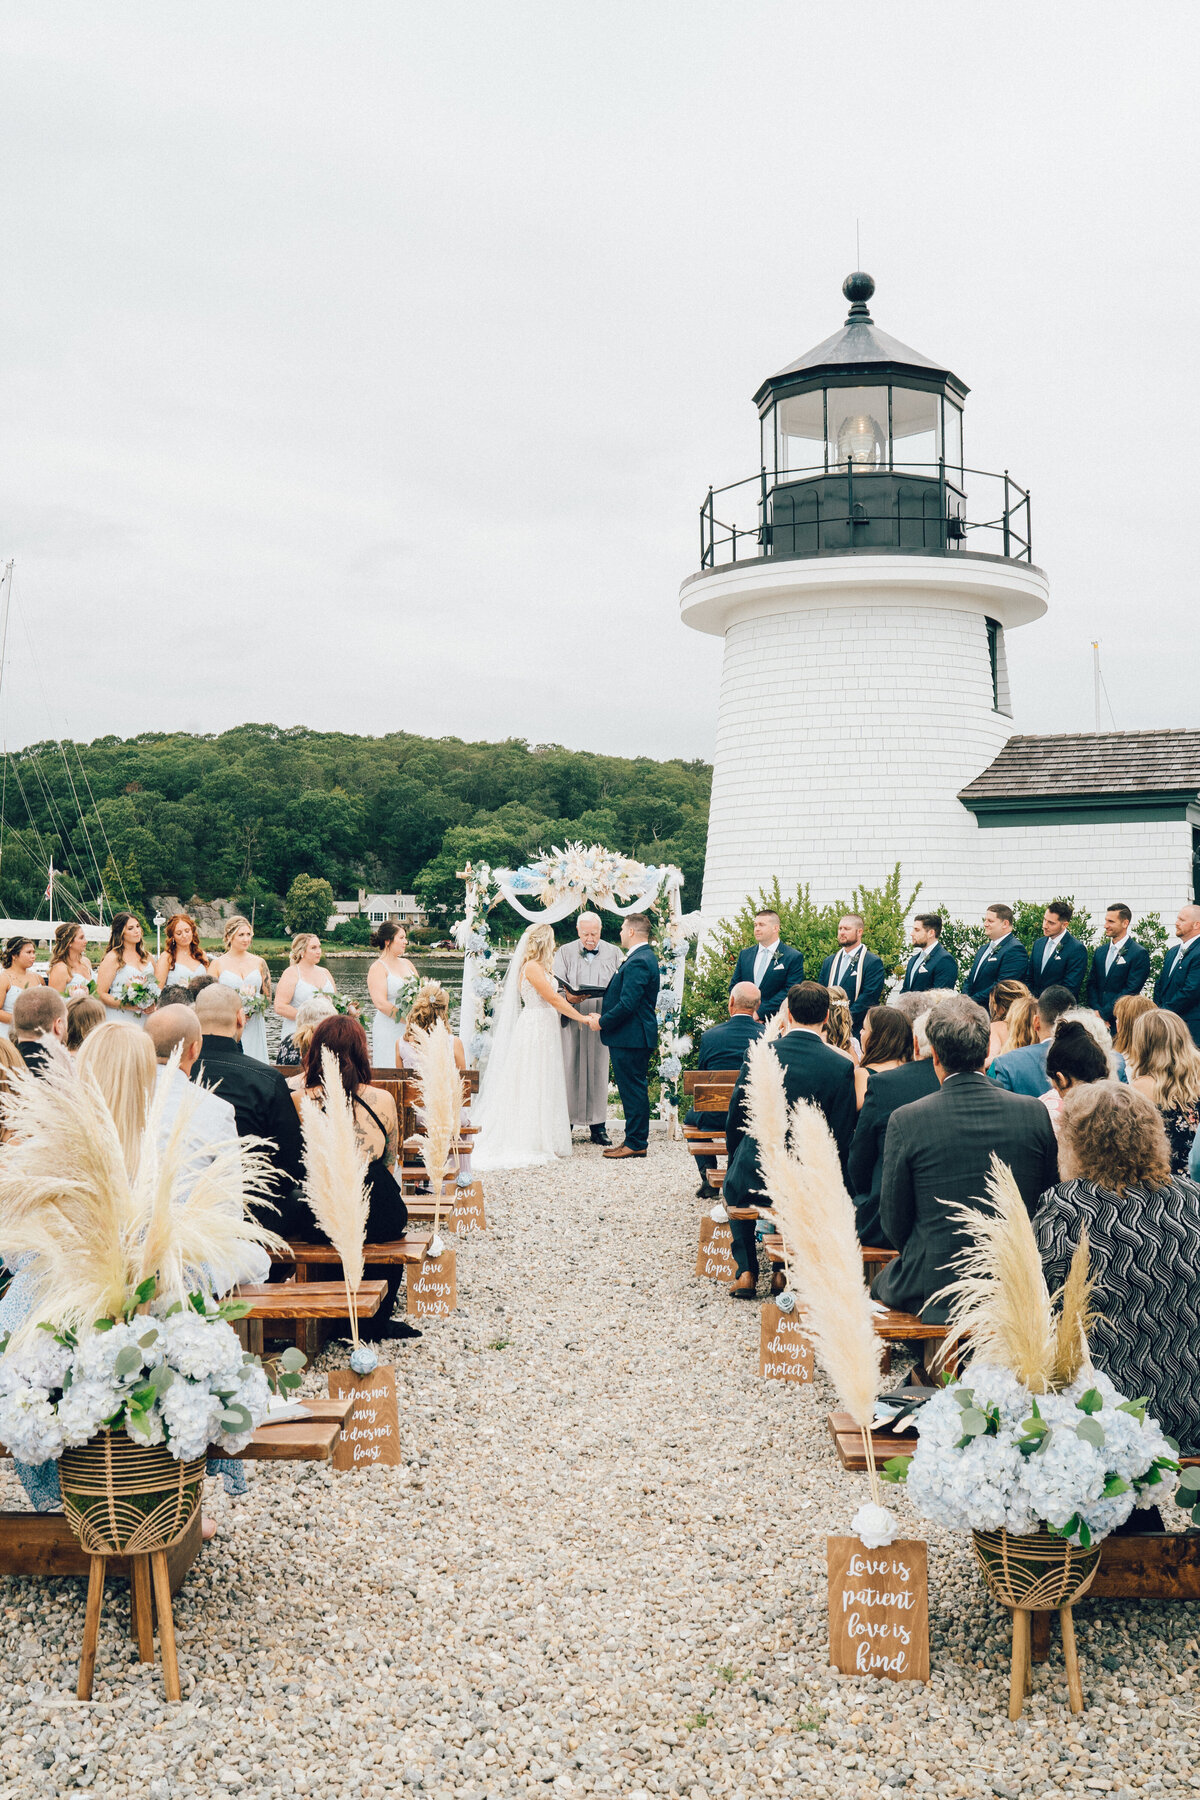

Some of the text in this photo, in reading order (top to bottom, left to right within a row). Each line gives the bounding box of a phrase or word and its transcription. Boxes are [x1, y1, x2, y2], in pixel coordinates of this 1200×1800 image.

[453, 1205, 481, 1217] never
[711, 1226, 732, 1240] Love
[703, 1241, 734, 1260] alway
[421, 1260, 443, 1275] Love
[705, 1258, 732, 1277] hopes
[413, 1277, 451, 1297] always
[416, 1299, 449, 1314] trusts
[776, 1316, 800, 1333] Love
[767, 1335, 807, 1359] always
[764, 1362, 808, 1380] protects
[338, 1385, 389, 1402] It does not
[352, 1409, 378, 1424] envy
[349, 1426, 375, 1441] does
[374, 1424, 393, 1438] not
[353, 1443, 381, 1461] boast
[846, 1553, 911, 1581] Love is
[842, 1587, 915, 1613] patient
[847, 1612, 911, 1645] love is
[856, 1641, 909, 1673] kind
